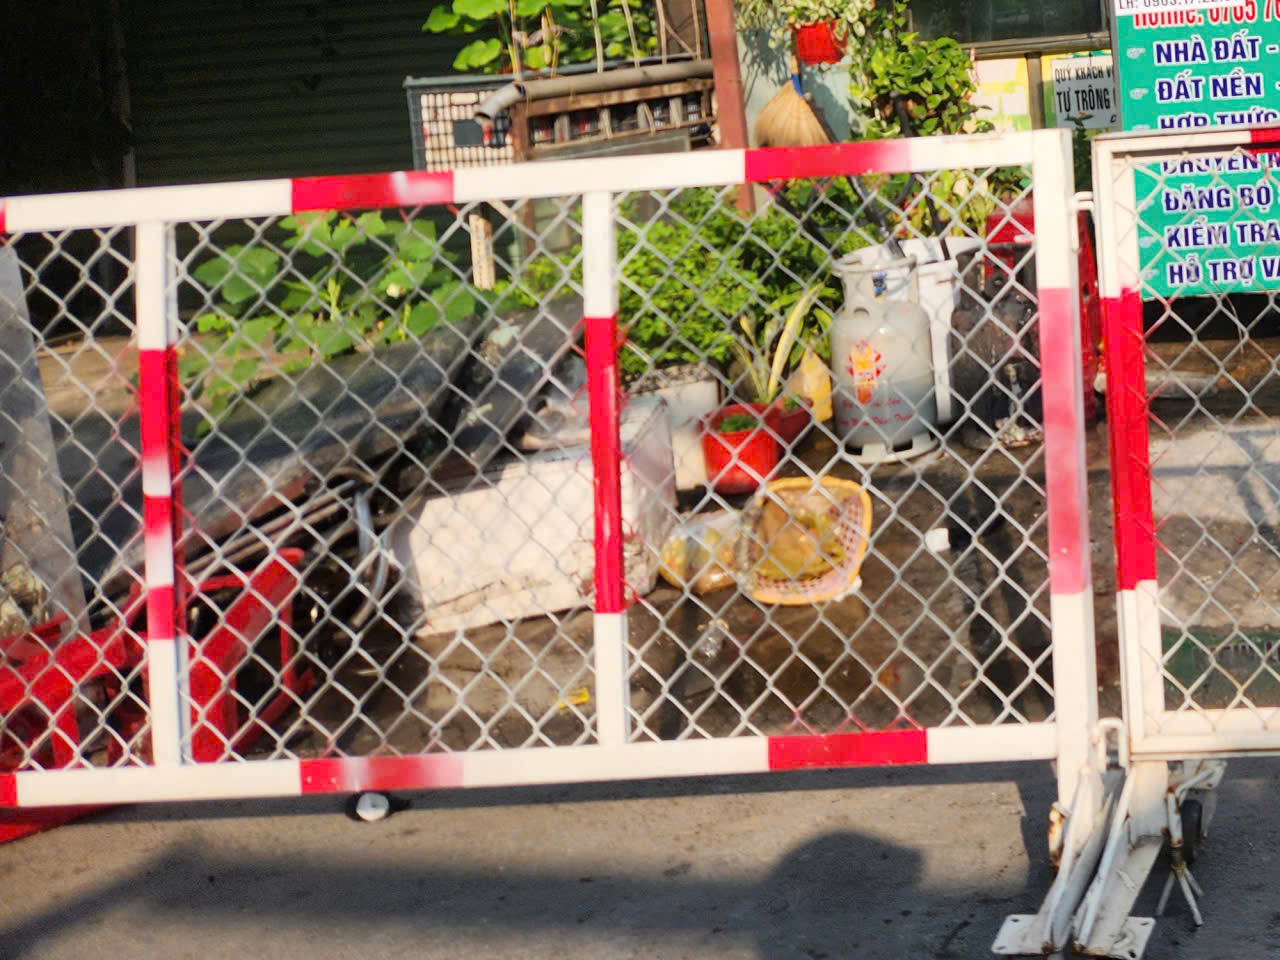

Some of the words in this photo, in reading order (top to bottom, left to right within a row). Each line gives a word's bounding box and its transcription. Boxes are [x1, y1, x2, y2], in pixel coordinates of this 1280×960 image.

[1155, 35, 1206, 64] NHÀ
[1214, 30, 1260, 61] ĐẤT
[1158, 71, 1203, 101] ĐẤT
[1211, 69, 1263, 98] NỀN
[1164, 184, 1231, 211] ĐĂNG
[1237, 222, 1280, 244] TRA
